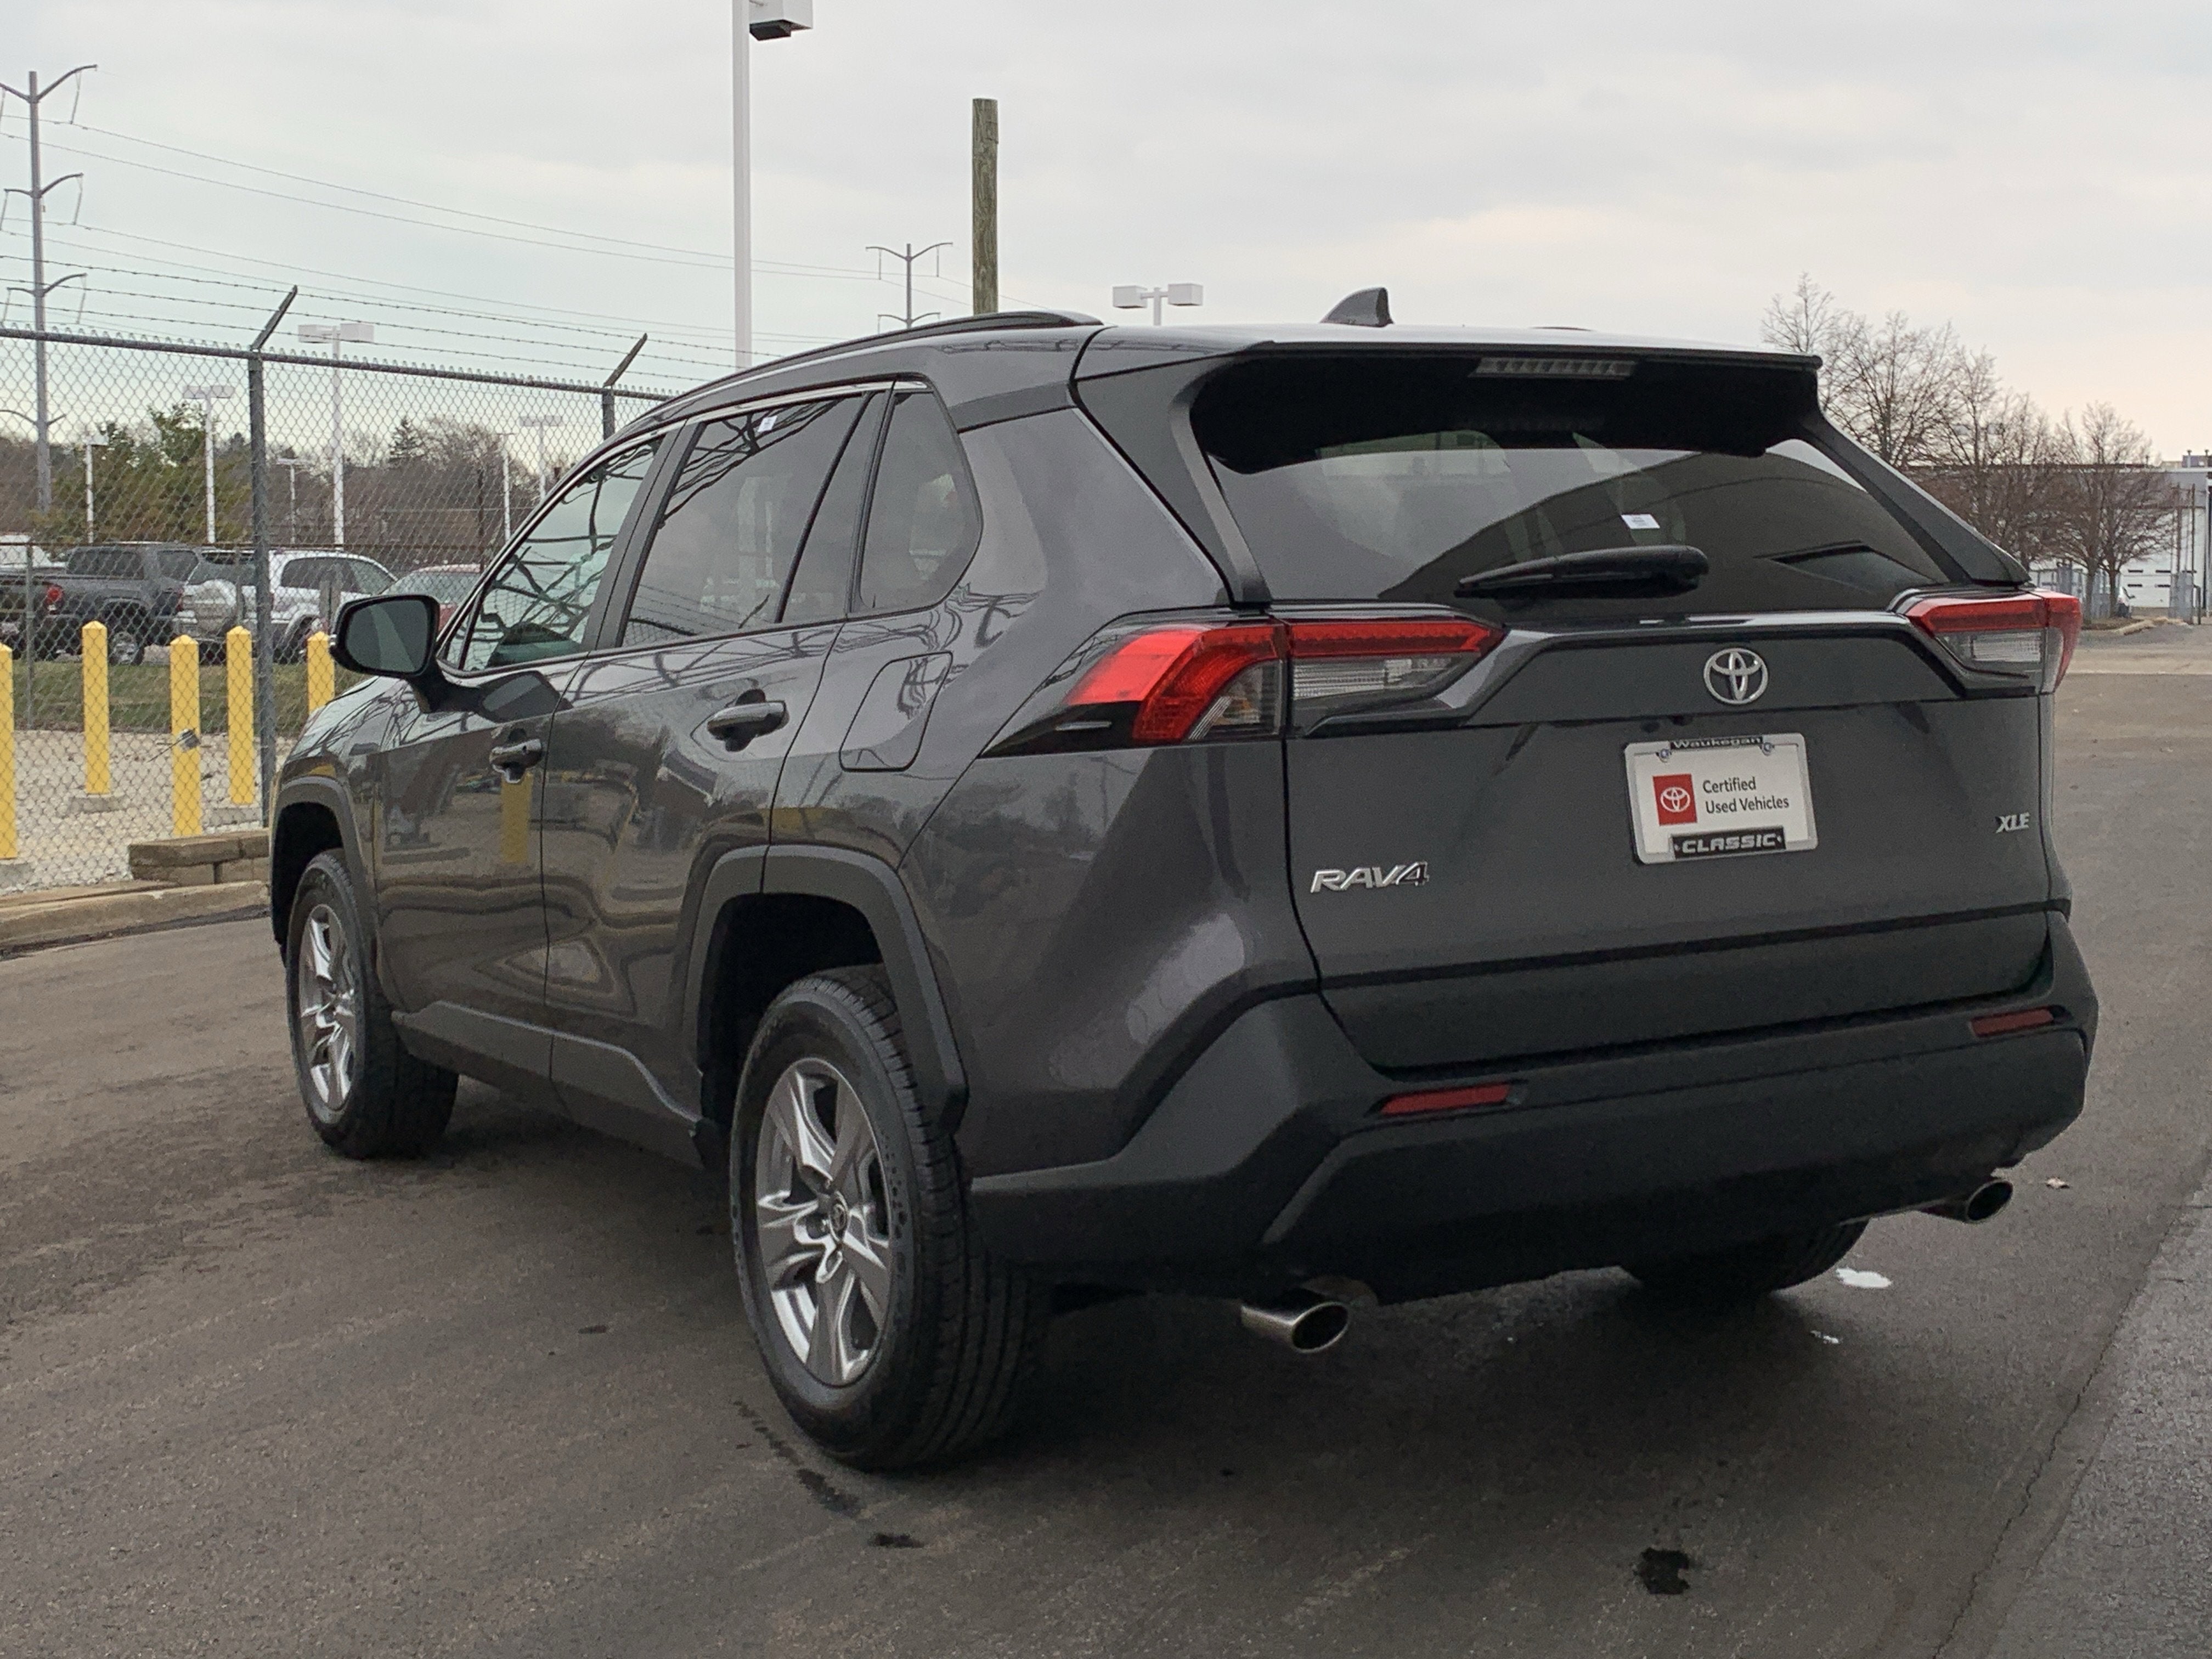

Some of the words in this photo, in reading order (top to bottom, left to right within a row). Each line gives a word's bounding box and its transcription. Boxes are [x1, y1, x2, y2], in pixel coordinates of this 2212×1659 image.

[1702, 776, 1756, 793] Certified
[1706, 798, 1737, 814] Used
[1739, 795, 1790, 811] Vehicles
[1996, 812, 2030, 833] XLE
[1682, 833, 1777, 854] CLASSIC
[1310, 861, 1430, 893] RAV4
